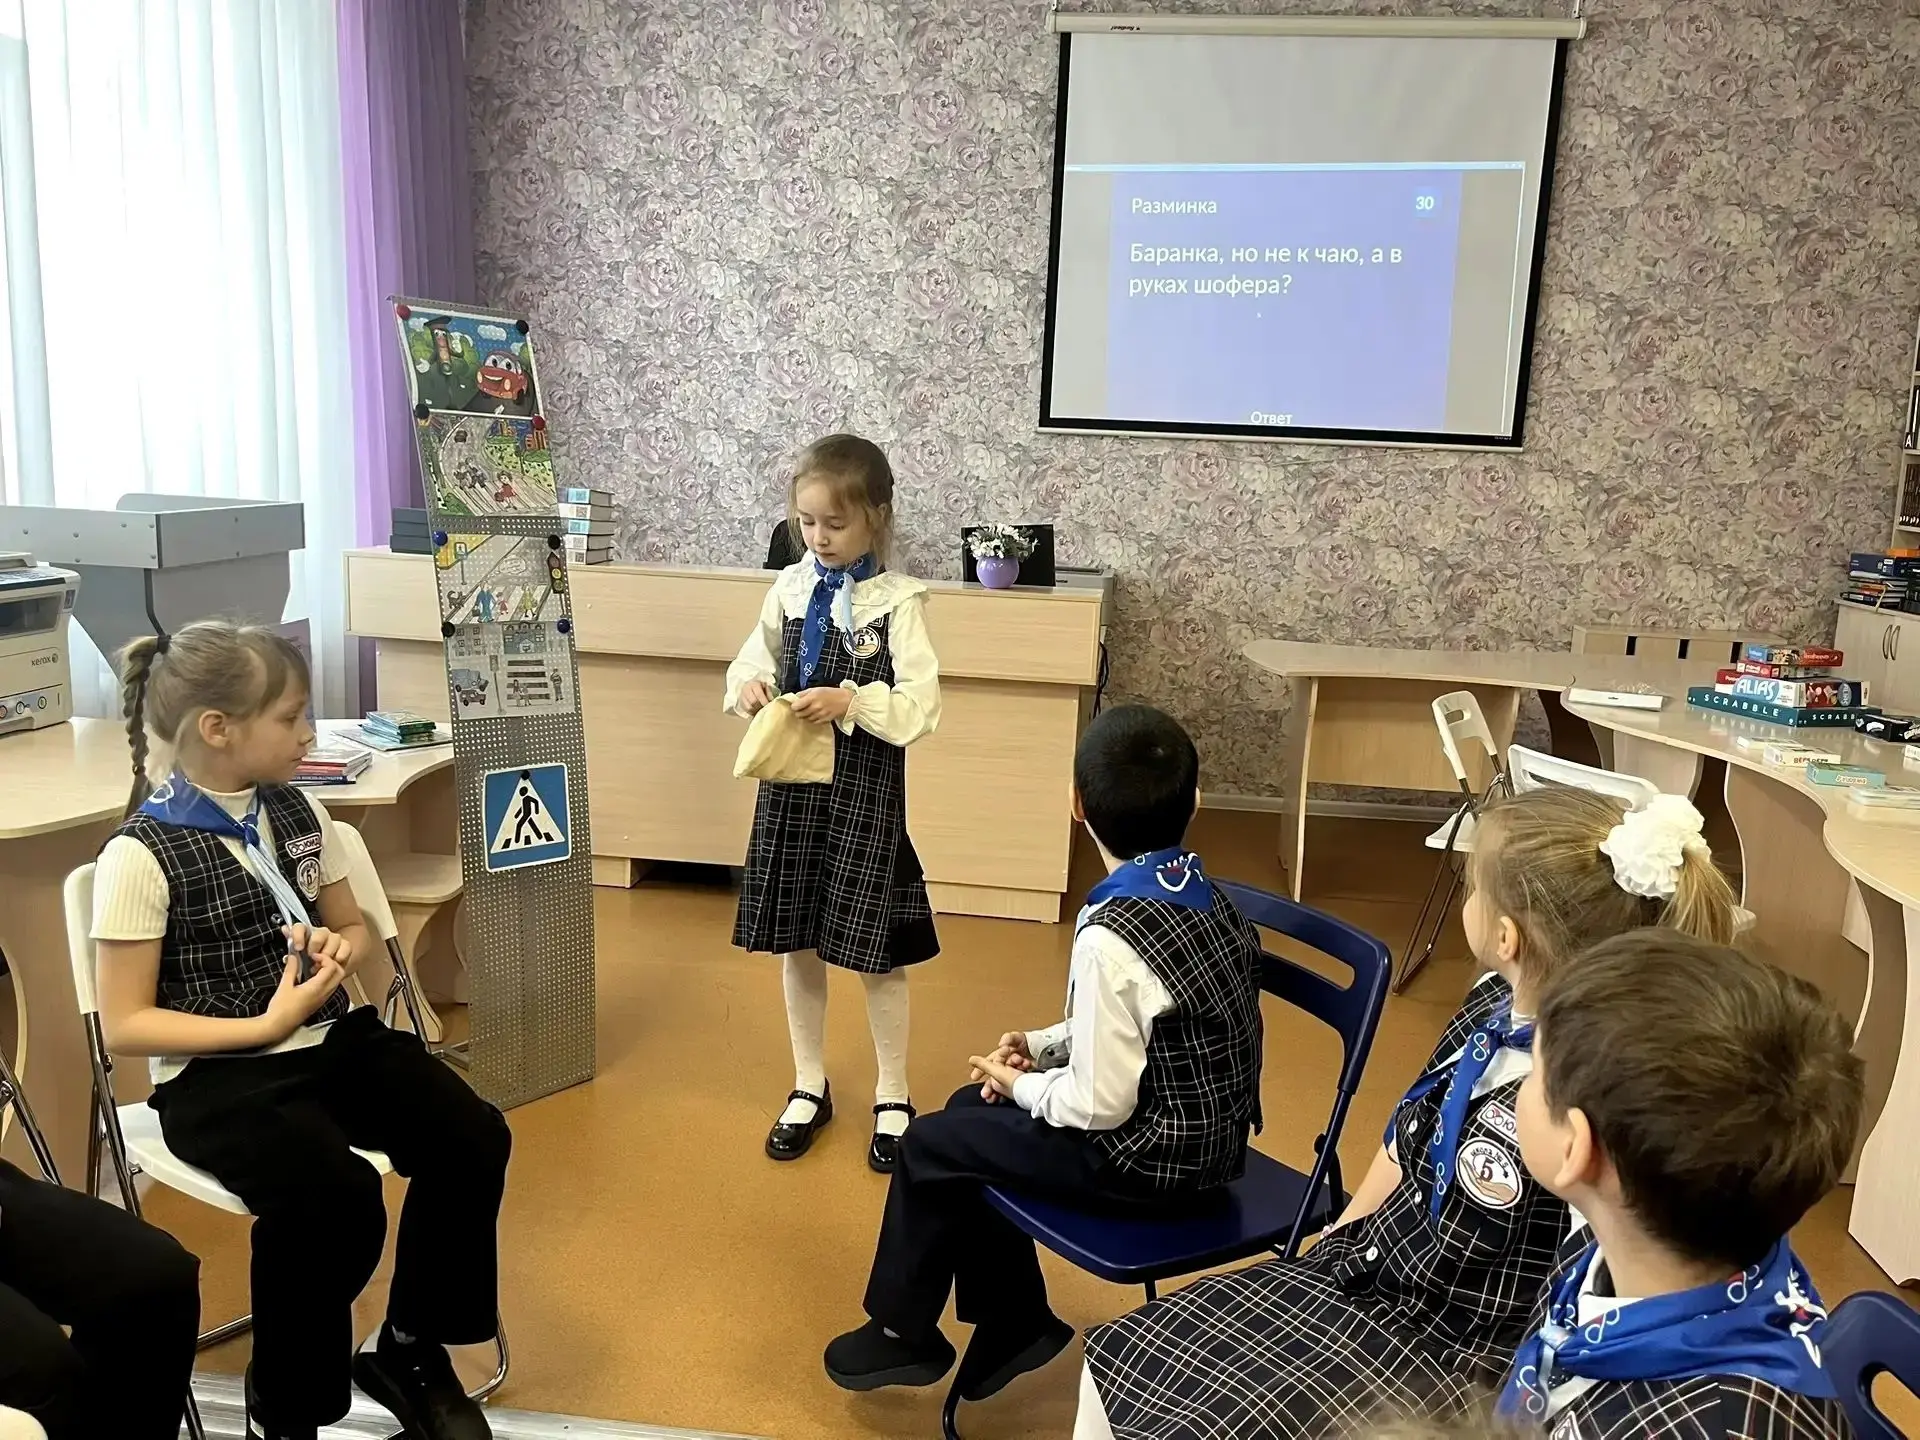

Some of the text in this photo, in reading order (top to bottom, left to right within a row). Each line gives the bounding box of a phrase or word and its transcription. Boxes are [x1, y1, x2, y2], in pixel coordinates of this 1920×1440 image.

[1131, 198, 1217, 214] Разминка
[1415, 196, 1434, 210] 30
[1130, 243, 1403, 266] Баранка, но не к чаю, а в
[1129, 273, 1292, 298] руках шофера?
[1250, 411, 1293, 425] Ответ
[1736, 678, 1776, 701] ALIAS
[1704, 693, 1779, 717] SCRABBLE
[1480, 1156, 1495, 1182] 5
